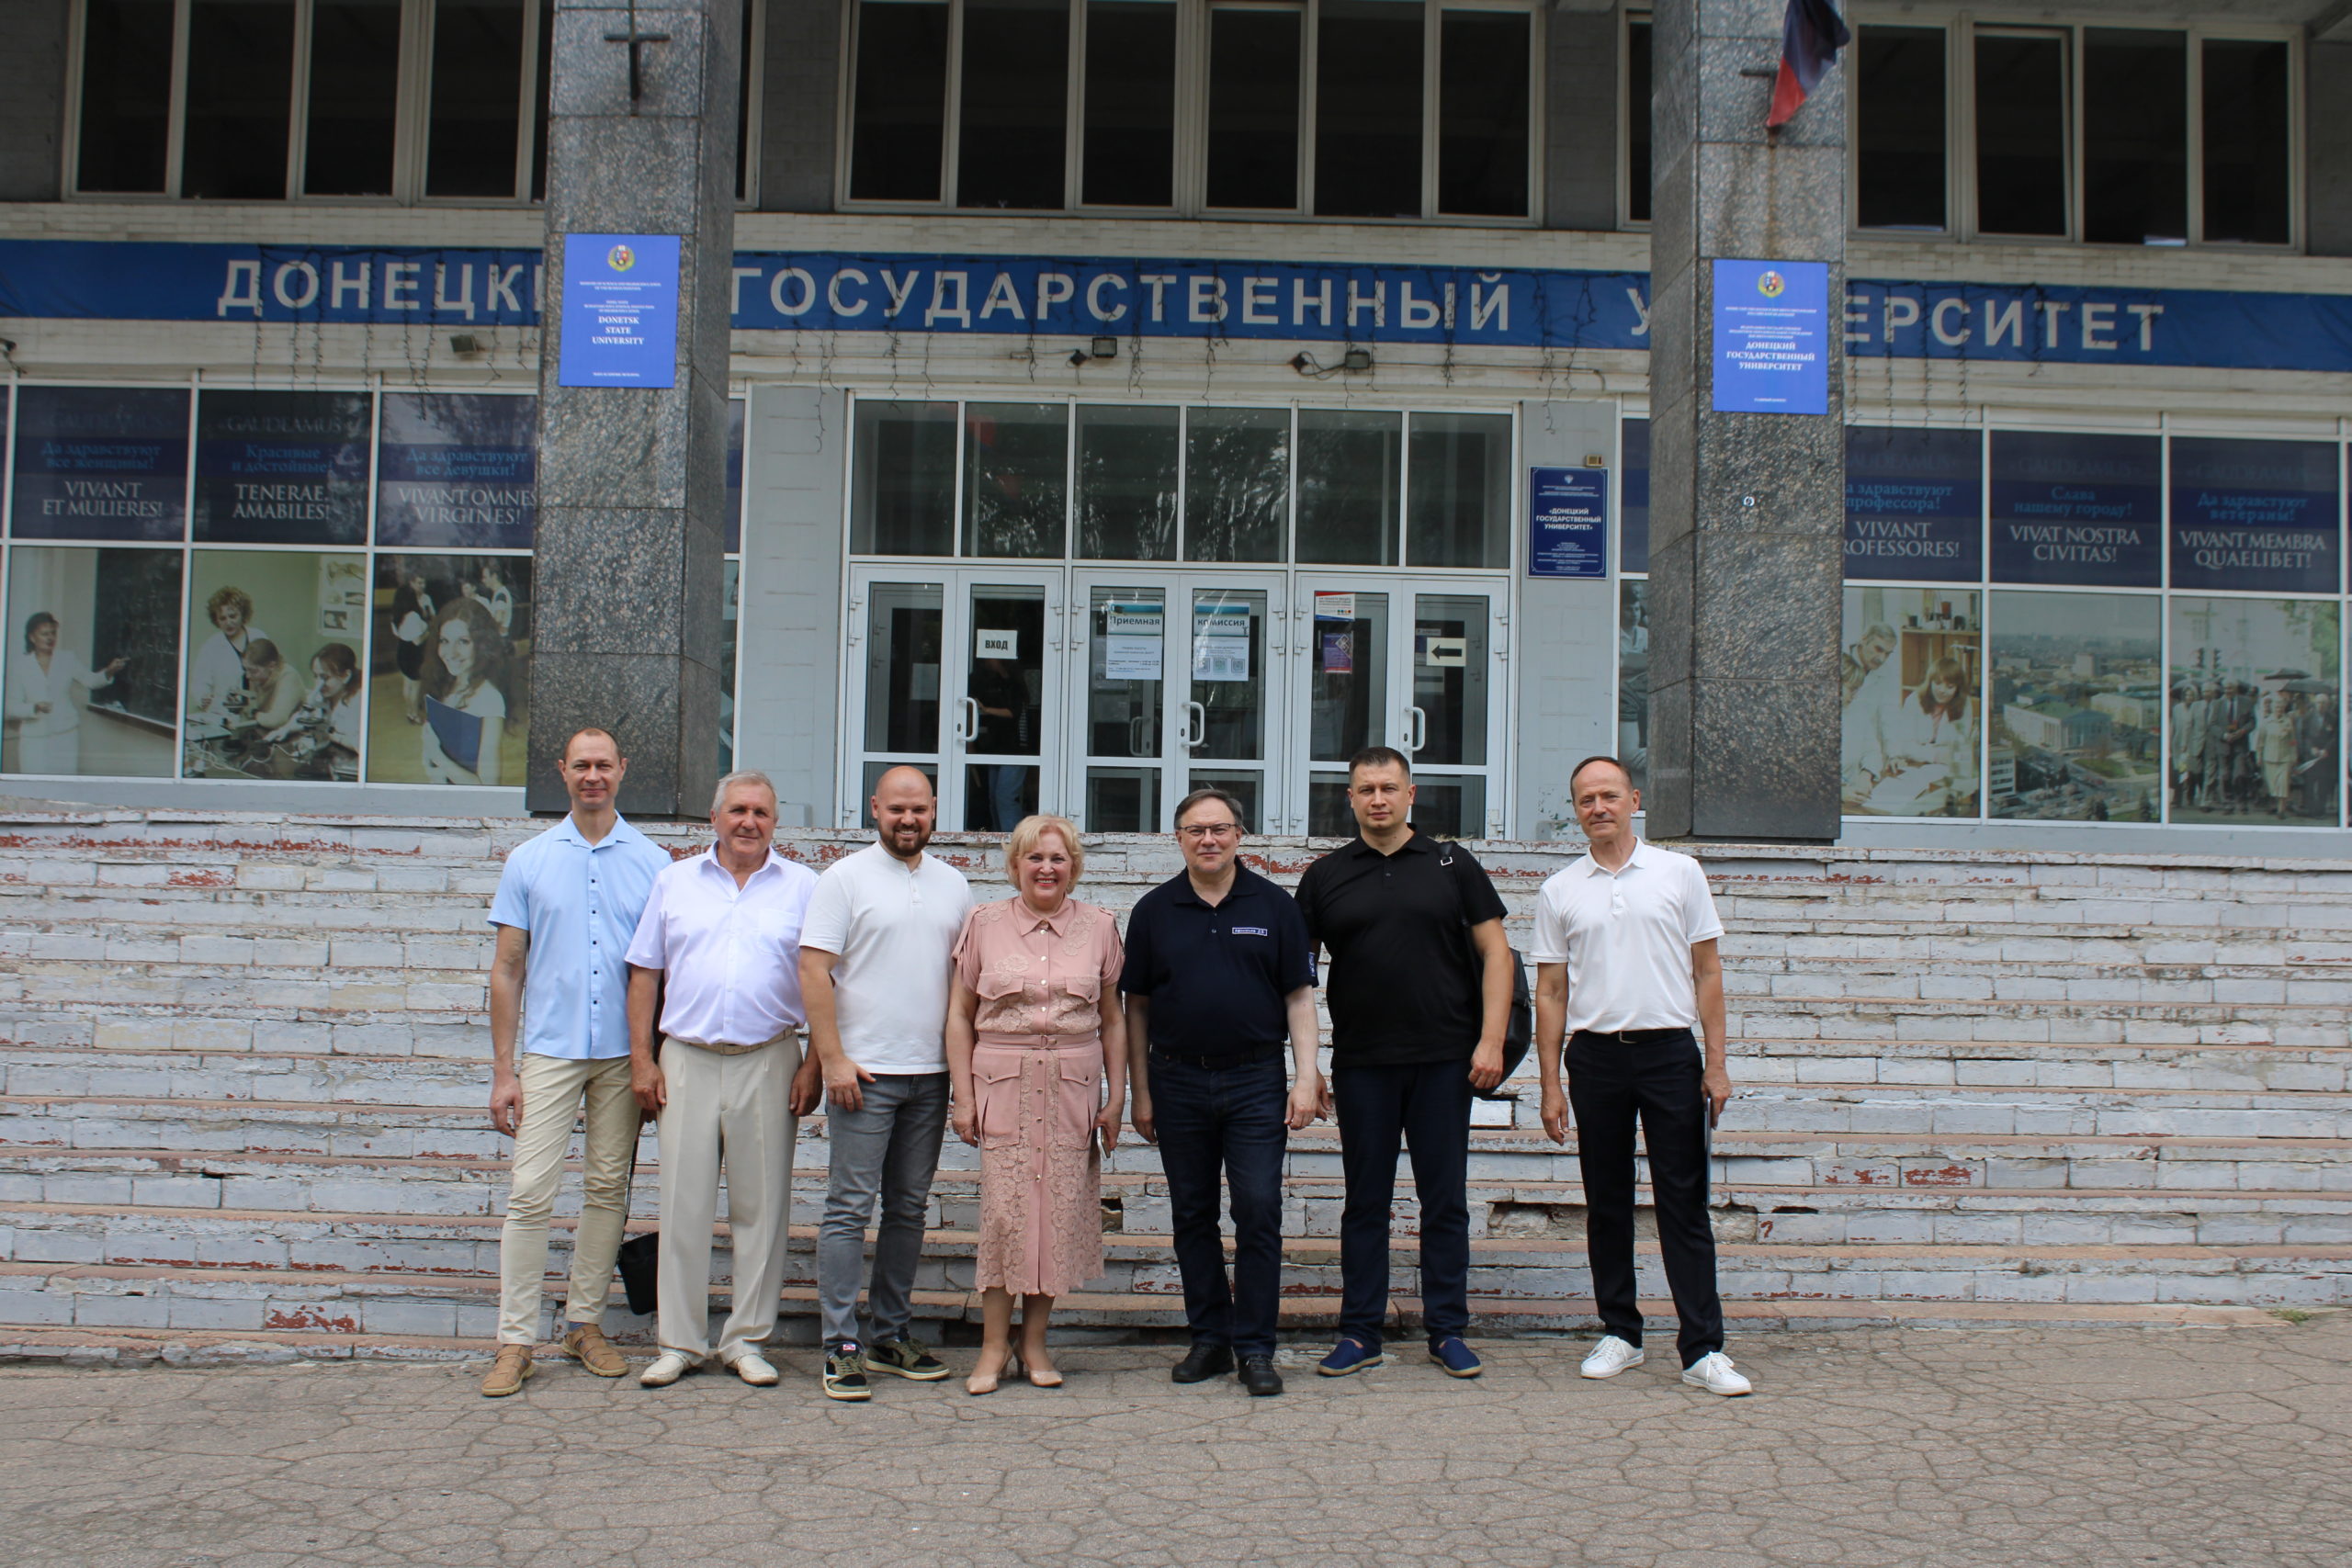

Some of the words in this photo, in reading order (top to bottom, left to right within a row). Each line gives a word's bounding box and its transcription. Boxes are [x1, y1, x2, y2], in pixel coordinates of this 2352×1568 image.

[217, 258, 543, 320] ДОНЕЦК
[732, 266, 1509, 332] ГОСУДАРСТВЕННЫЙ
[598, 316, 639, 324] DONETSK
[605, 326, 631, 334] STATE
[592, 336, 645, 345] UNIVERSITY
[1746, 341, 1796, 351] ДОНЕЦКИЙ
[1726, 351, 1815, 361] ГОСУДАРСТВЕННЫЙ
[1738, 362, 1803, 371] УНИВЕРСИТЕТ
[41, 442, 62, 456] Да
[65, 446, 162, 458] здравствуют
[246, 445, 321, 459] Красивые
[406, 448, 426, 461] Да
[431, 452, 529, 465] здравствуют
[47, 458, 71, 468] все
[416, 465, 440, 476] все
[445, 465, 515, 478] девушки!
[64, 480, 143, 499] VIVANT
[399, 487, 469, 505] VIVANT
[1858, 485, 1953, 498] здравствуют
[2051, 486, 2096, 501] Слава
[1845, 497, 1940, 512] профессора!
[2198, 492, 2219, 506] Да
[42, 500, 65, 515] ET
[67, 501, 163, 517] MULIERES!
[232, 503, 330, 520] AMABILES!
[415, 507, 521, 525] VIRGINES!
[2014, 502, 2073, 517] нашему
[2075, 502, 2133, 520] городу!
[2210, 509, 2295, 525] ветераны!
[1856, 521, 1932, 538] VIVANT
[2010, 525, 2063, 542] VIVAT
[2066, 527, 2141, 545] NOSTRA
[1843, 539, 1960, 558] ROFESSORES!
[2179, 530, 2248, 547] VIVANT
[2248, 533, 2327, 551] MEMBRA
[2033, 545, 2117, 562] CIVITAS!
[2195, 550, 2312, 570] QUAELIBET!
[1109, 615, 1160, 626] Приемная
[985, 640, 1008, 650] ВХОД
